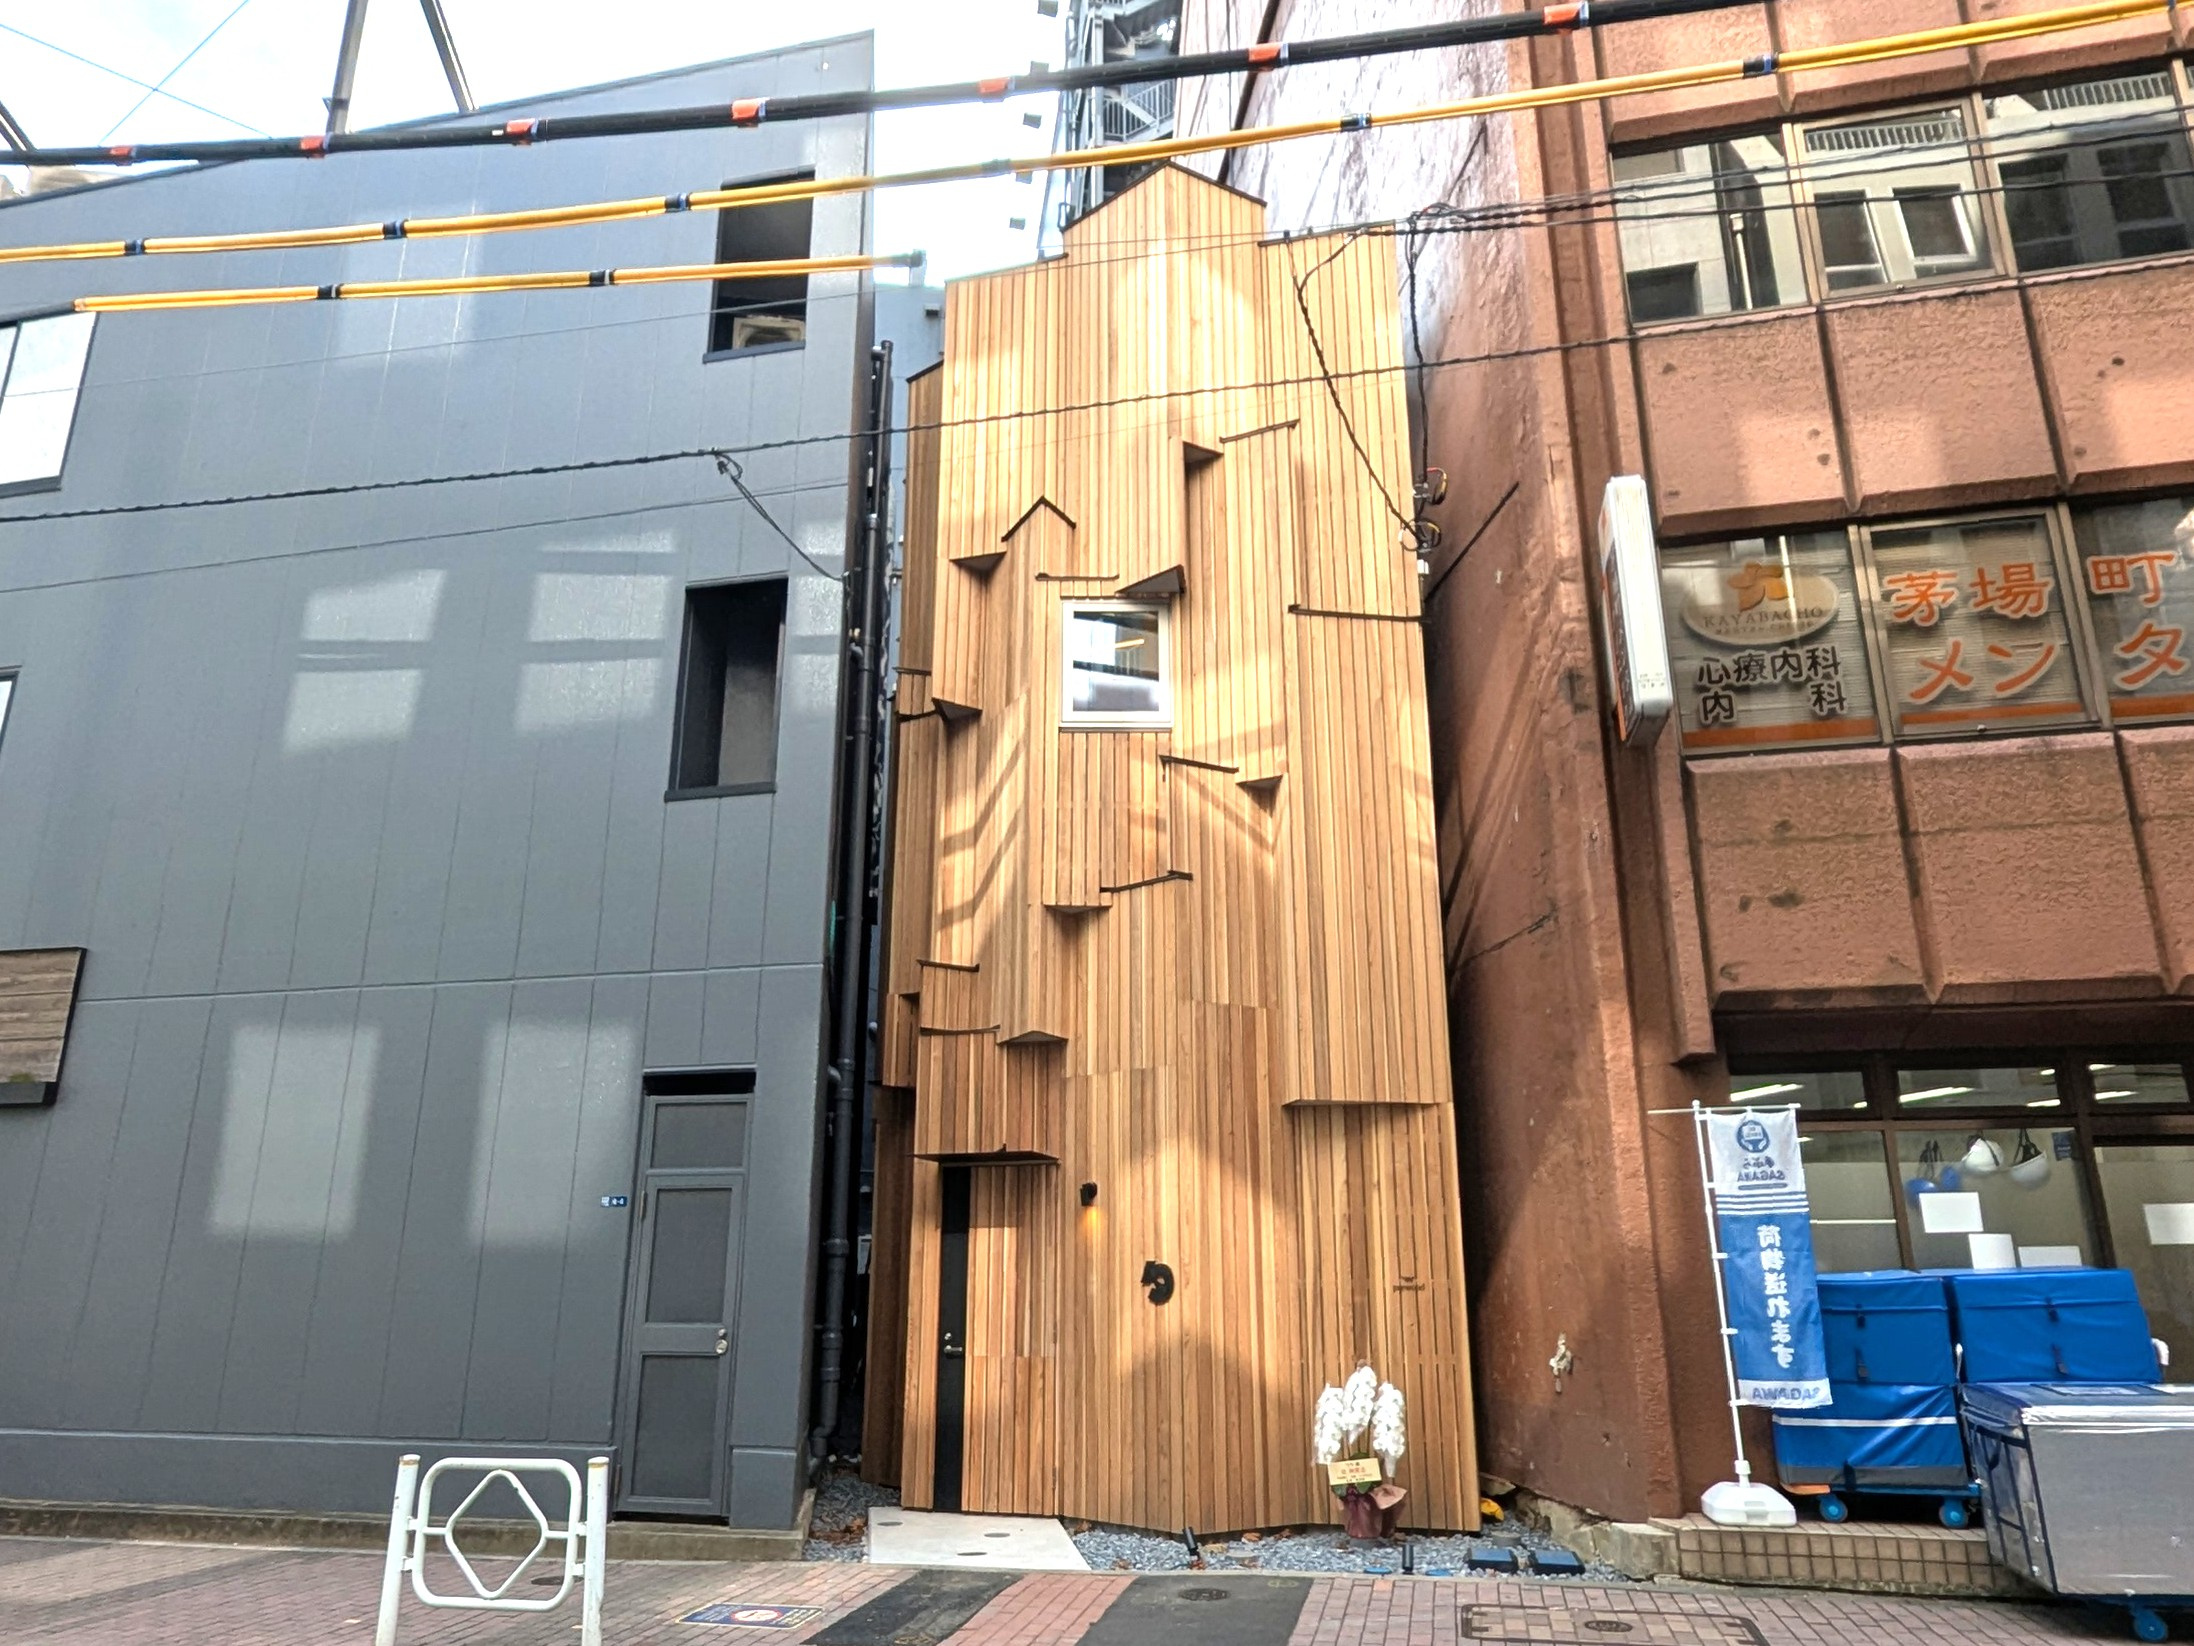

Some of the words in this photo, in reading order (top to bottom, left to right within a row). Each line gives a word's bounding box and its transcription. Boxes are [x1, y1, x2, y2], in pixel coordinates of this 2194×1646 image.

[1886, 554, 2176, 623] 茅場町
[1704, 606, 1822, 628] KAYABACHO
[1697, 645, 1842, 685] 心療内科
